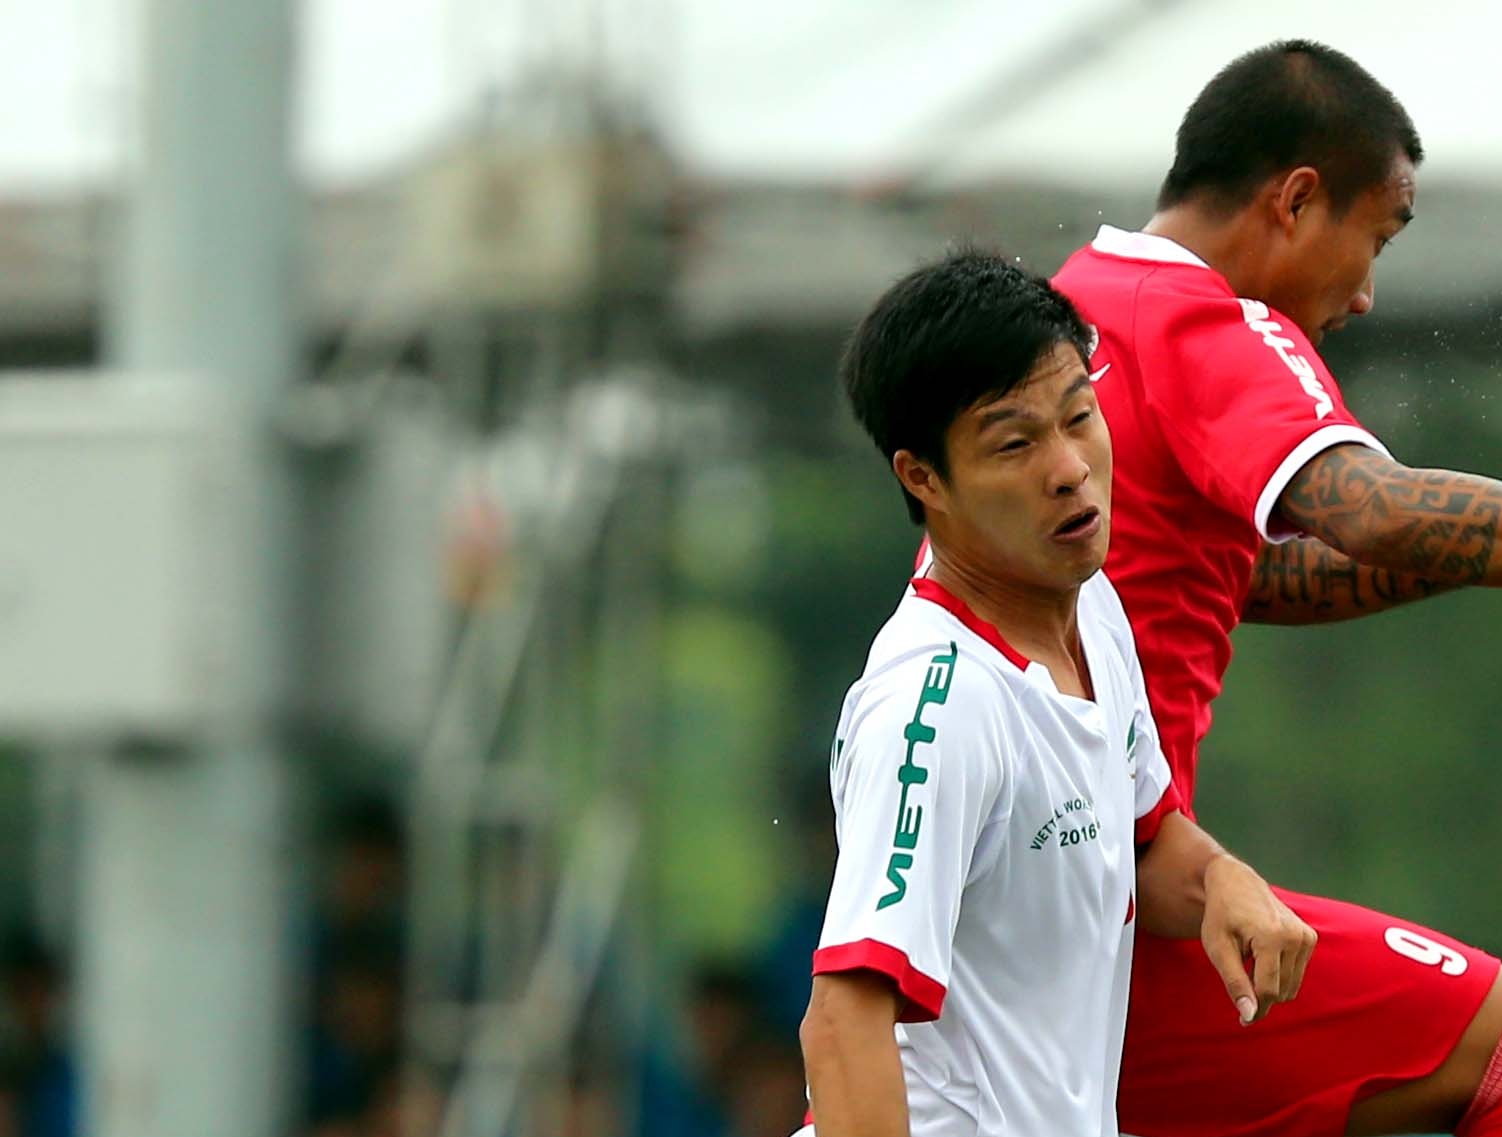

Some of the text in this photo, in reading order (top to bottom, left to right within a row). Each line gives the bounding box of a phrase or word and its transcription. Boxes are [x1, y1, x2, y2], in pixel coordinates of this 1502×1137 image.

[1233, 297, 1334, 421] VIETTE
[876, 640, 958, 912] VIETTEL
[1030, 809, 1063, 851] VIETTL
[1060, 823, 1097, 847] 2016
[1384, 927, 1468, 976] 9
